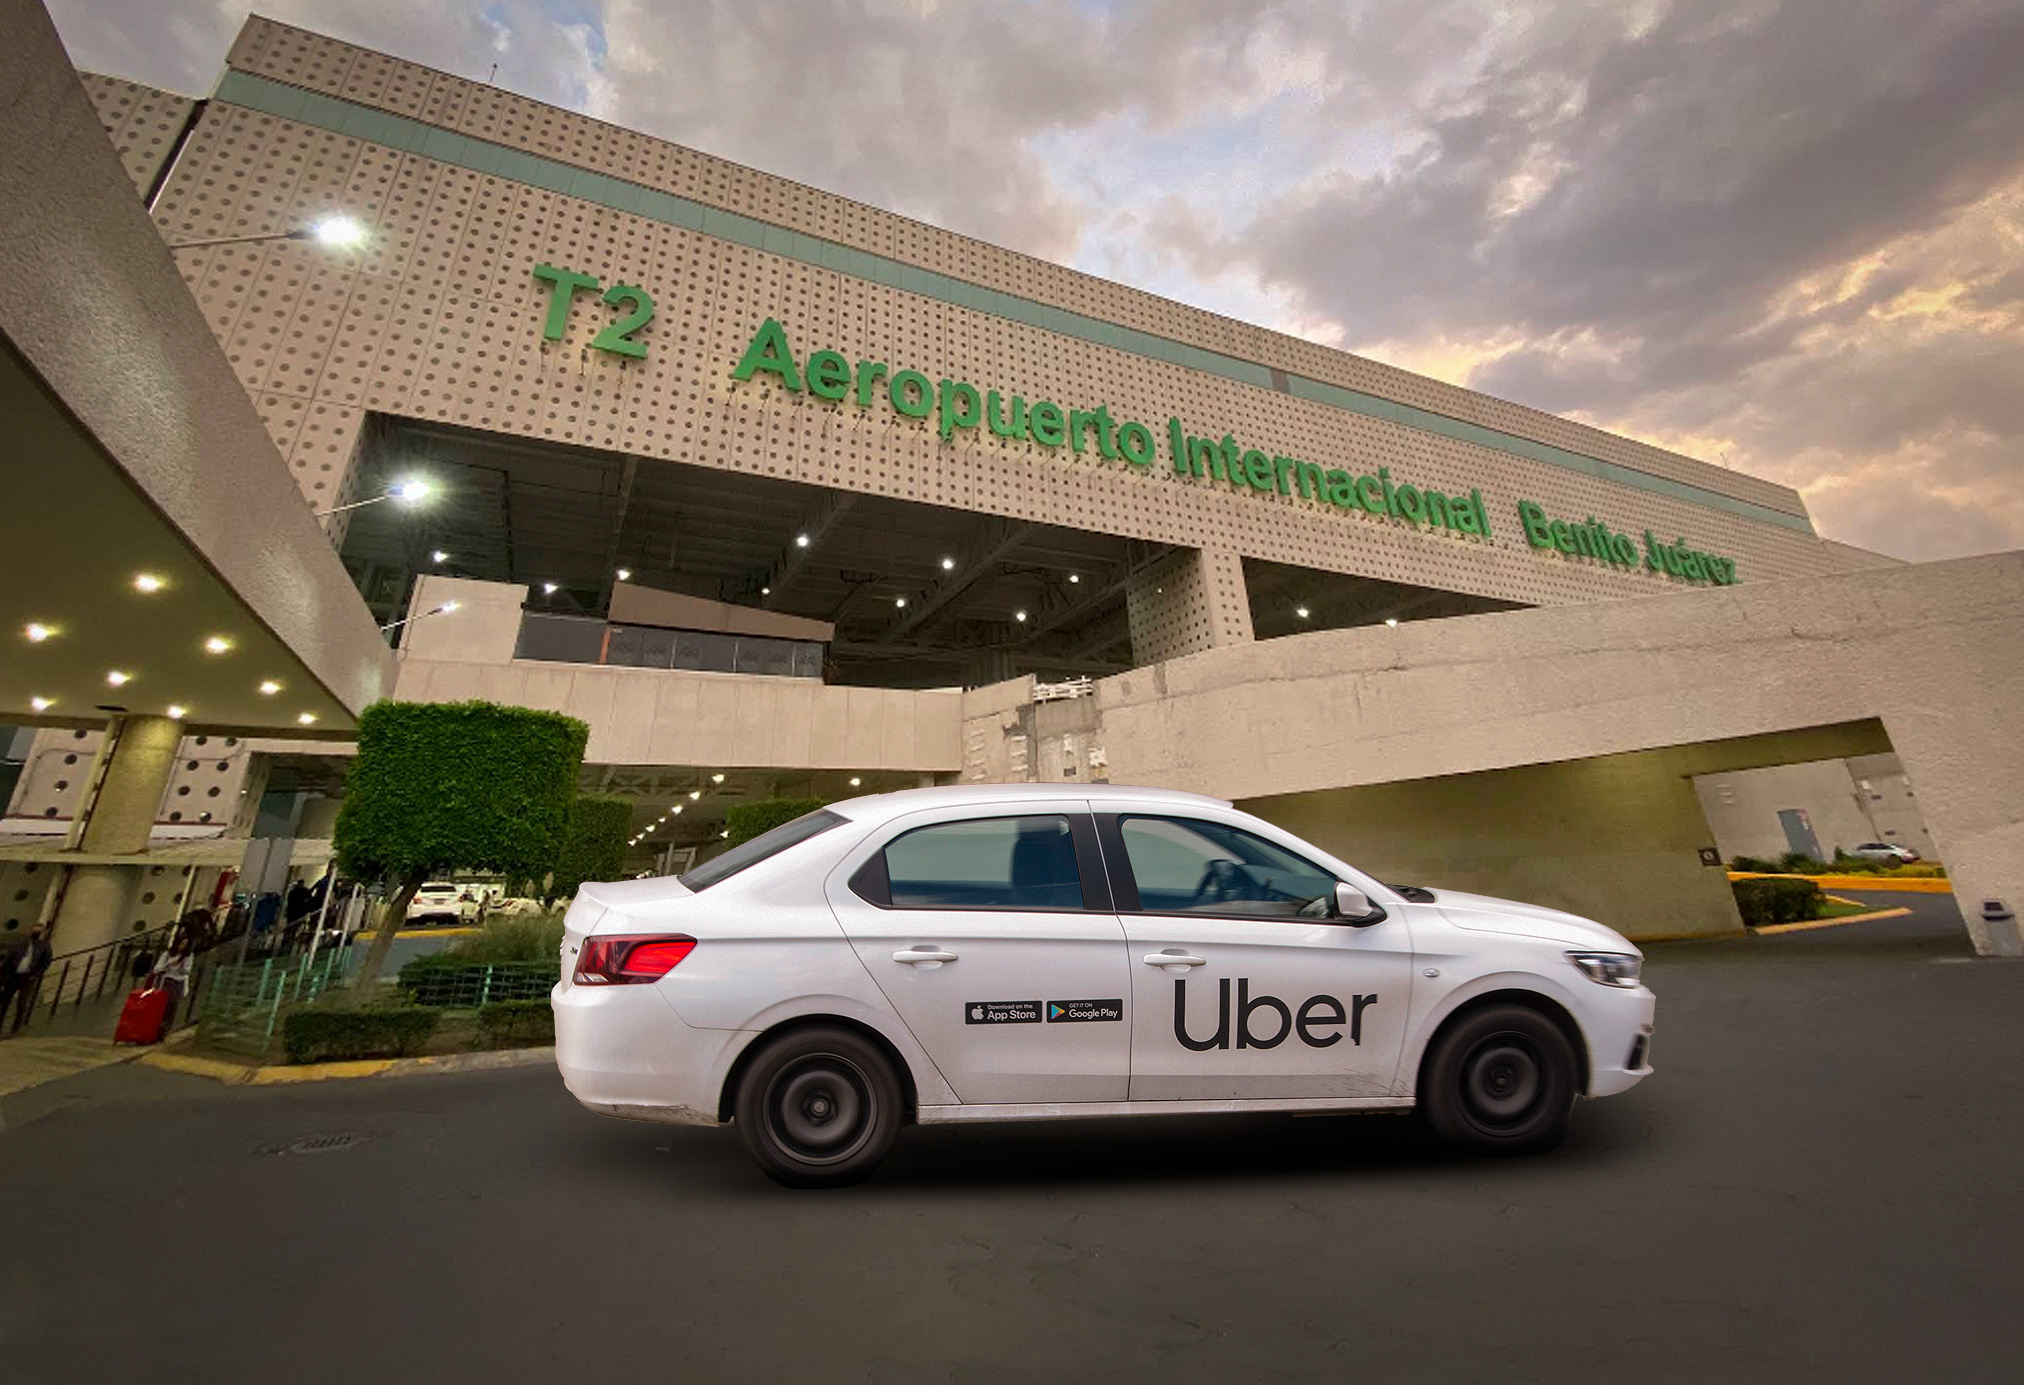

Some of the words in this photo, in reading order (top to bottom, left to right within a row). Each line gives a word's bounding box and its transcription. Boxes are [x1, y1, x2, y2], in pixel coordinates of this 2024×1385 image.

[534, 264, 654, 360] T2
[732, 317, 1156, 465] Aeropuerto
[1169, 417, 1493, 537] Internacional
[1517, 500, 1640, 567] Benito
[1644, 529, 1742, 586] Juárez
[987, 1010, 1008, 1021] App
[1009, 1009, 1036, 1020] Store
[1068, 1009, 1100, 1020] Google
[1100, 1008, 1118, 1019] Play
[1173, 977, 1378, 1052] Uber
